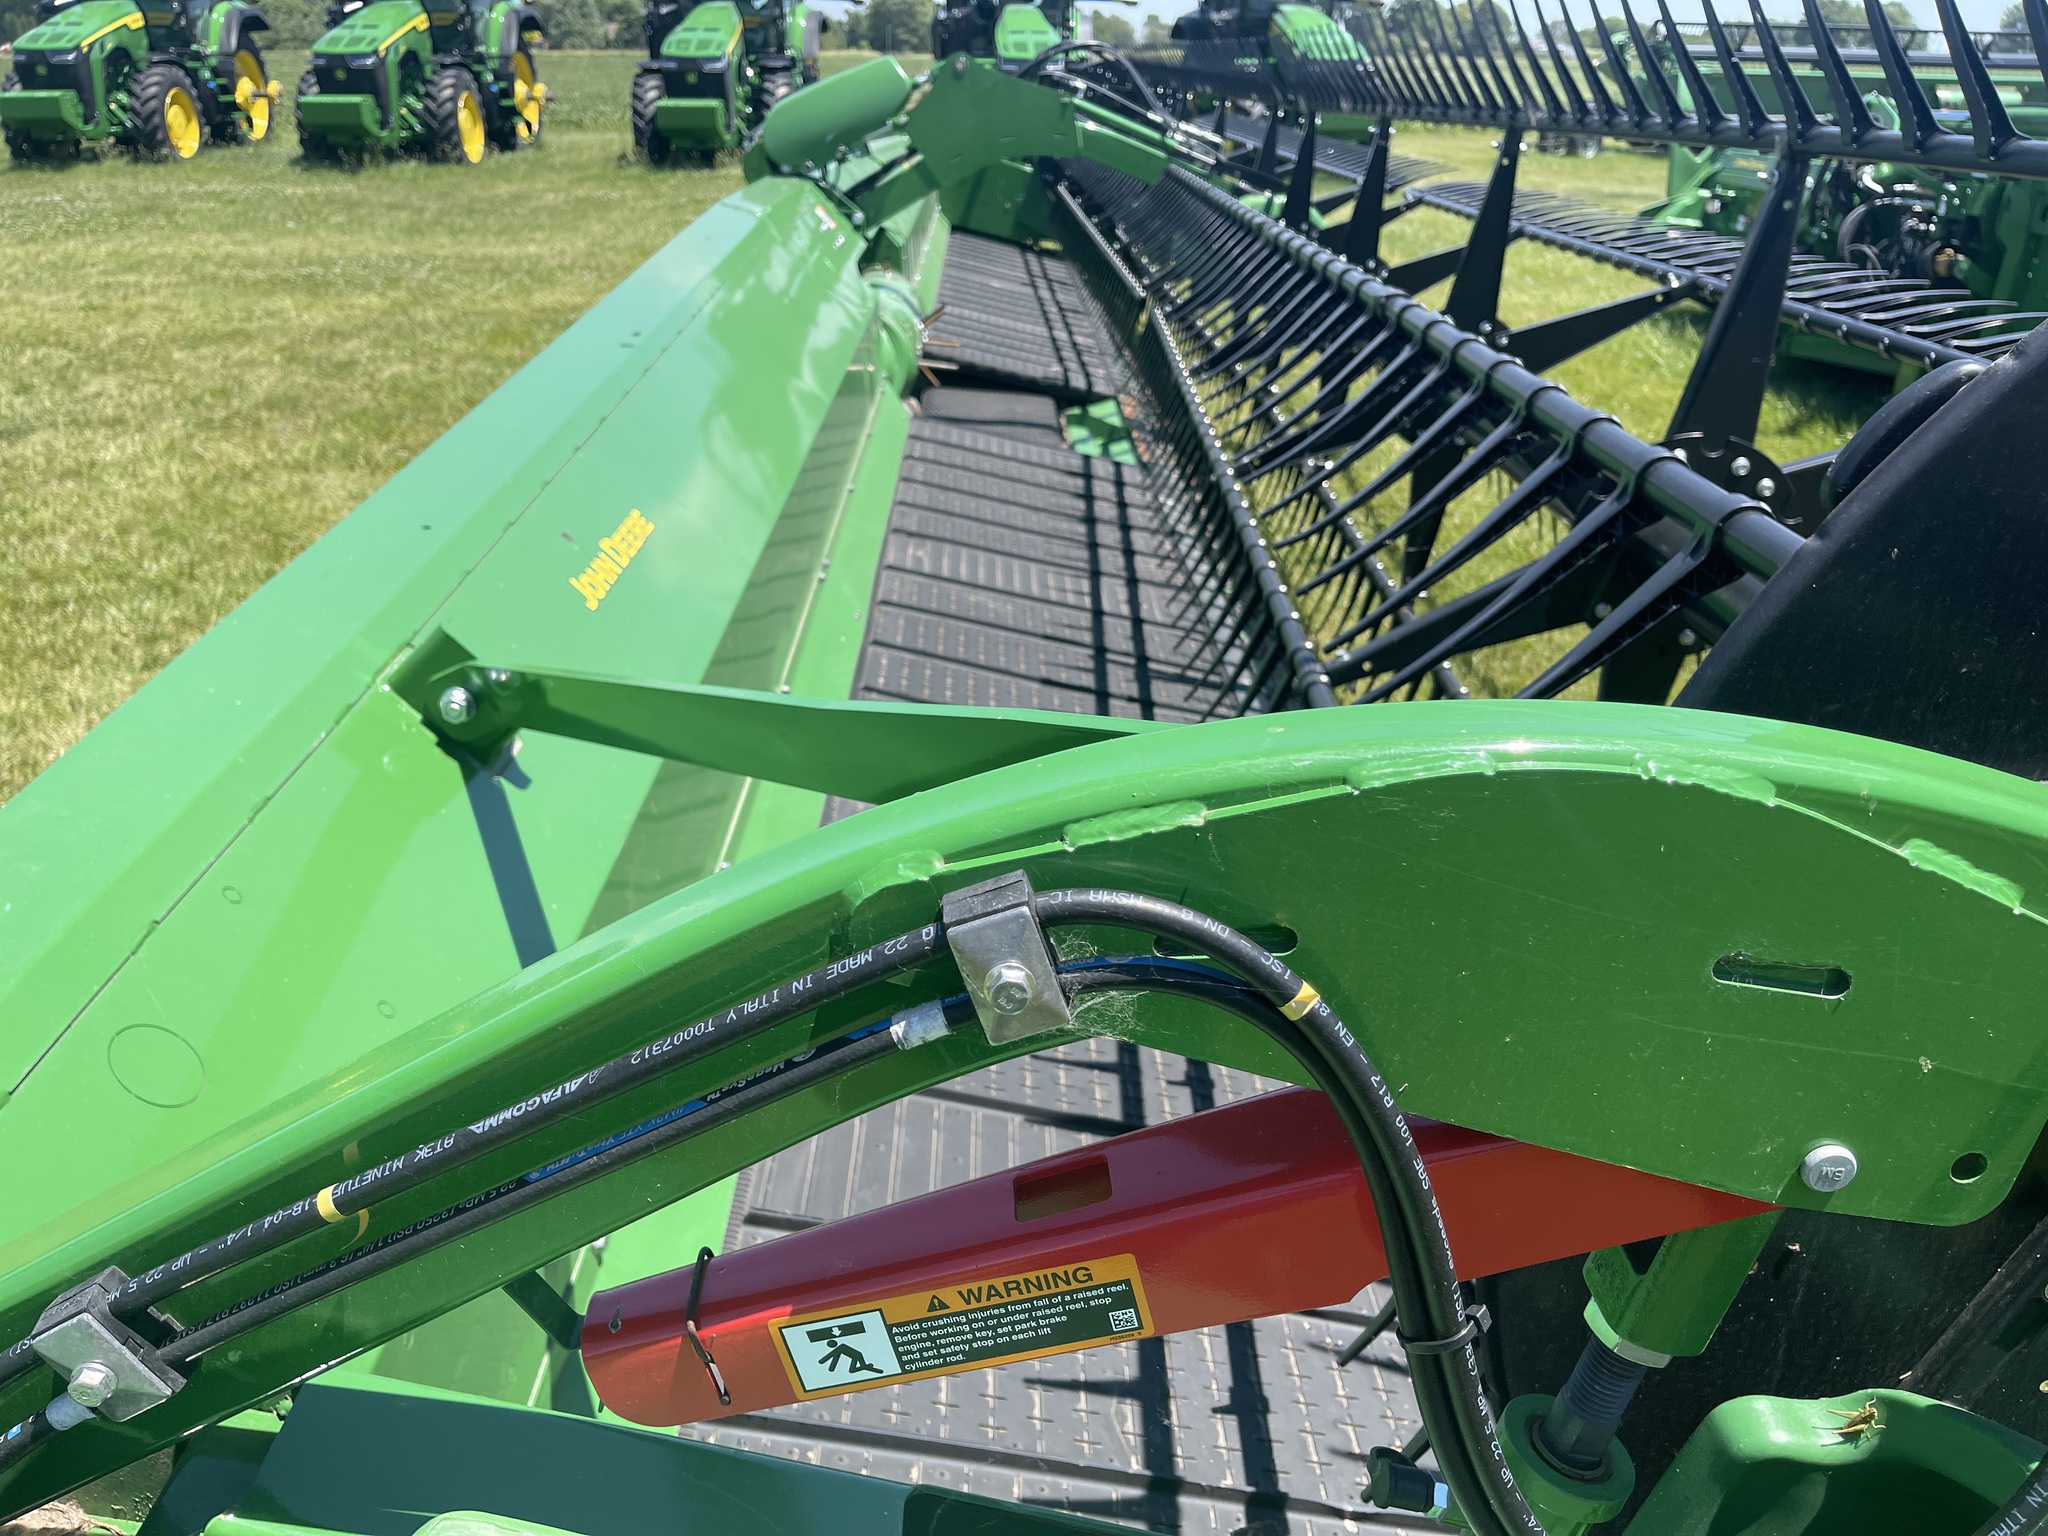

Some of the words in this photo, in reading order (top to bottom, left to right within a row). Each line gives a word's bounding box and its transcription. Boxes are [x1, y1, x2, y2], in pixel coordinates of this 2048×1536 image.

[1204, 918, 1230, 938] DN
[884, 935, 909, 955] 22
[826, 949, 873, 980] MADE
[792, 974, 813, 994] IN
[726, 989, 779, 1024] ITALY
[1335, 1020, 1355, 1047] EN
[468, 1073, 589, 1134] ALFAGOMMA
[1371, 1075, 1394, 1108] R17
[1396, 1115, 1413, 1147] 100
[414, 1133, 456, 1163] AT3K
[1413, 1155, 1430, 1190] SAE
[171, 1252, 192, 1271] WP
[957, 1266, 1094, 1305] WARNING
[892, 1323, 920, 1334] Avoid
[922, 1315, 966, 1329] crushing
[968, 1307, 1006, 1320] injuries
[1007, 1302, 1032, 1312] from
[1033, 1298, 1049, 1307] fall
[1051, 1295, 1062, 1303] of
[1073, 1287, 1104, 1299] raised
[1106, 1283, 1129, 1293] reel.
[894, 1331, 927, 1343] Before
[929, 1323, 970, 1337] working
[987, 1318, 998, 1326] or
[1000, 1312, 1029, 1323] under
[1032, 1305, 1063, 1317] raised
[1065, 1301, 1088, 1311] reel,
[1089, 1297, 1112, 1307] stop
[897, 1341, 935, 1352] engine,
[936, 1333, 973, 1345] remove
[975, 1328, 995, 1339] key,
[996, 1326, 1013, 1334] set
[1014, 1320, 1037, 1332] park
[1039, 1314, 1068, 1325] brake
[901, 1351, 920, 1361] and
[922, 1349, 938, 1358] set
[939, 1342, 970, 1354] safety
[972, 1338, 994, 1348] stop
[1012, 1330, 1036, 1341] each
[1037, 1326, 1052, 1336] lift
[904, 1356, 944, 1370] cylinder
[946, 1353, 967, 1363] rod.
